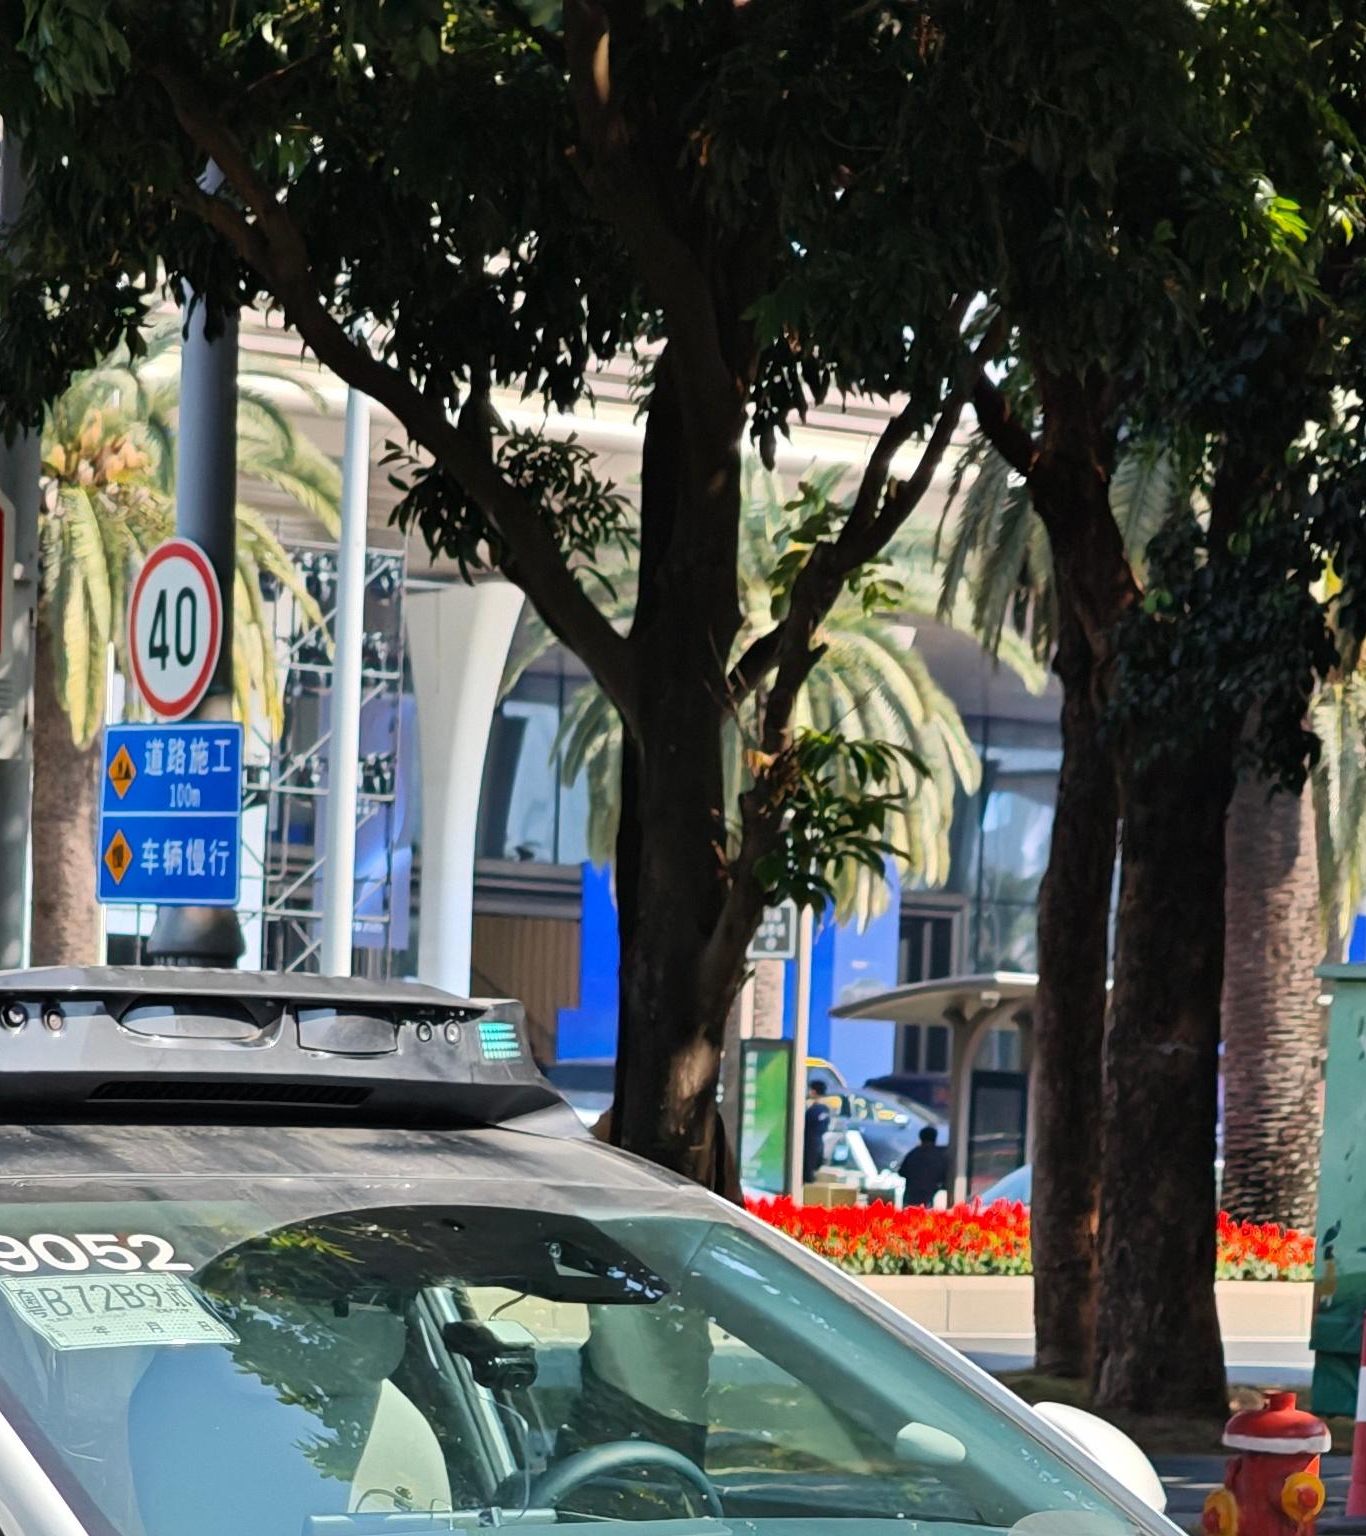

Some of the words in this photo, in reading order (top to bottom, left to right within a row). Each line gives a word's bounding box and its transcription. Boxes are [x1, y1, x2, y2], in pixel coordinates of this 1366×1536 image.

[147, 586, 199, 671] 40
[143, 737, 232, 776] 道路施工
[169, 783, 201, 808] 100m
[140, 838, 230, 877] 车辆慢行
